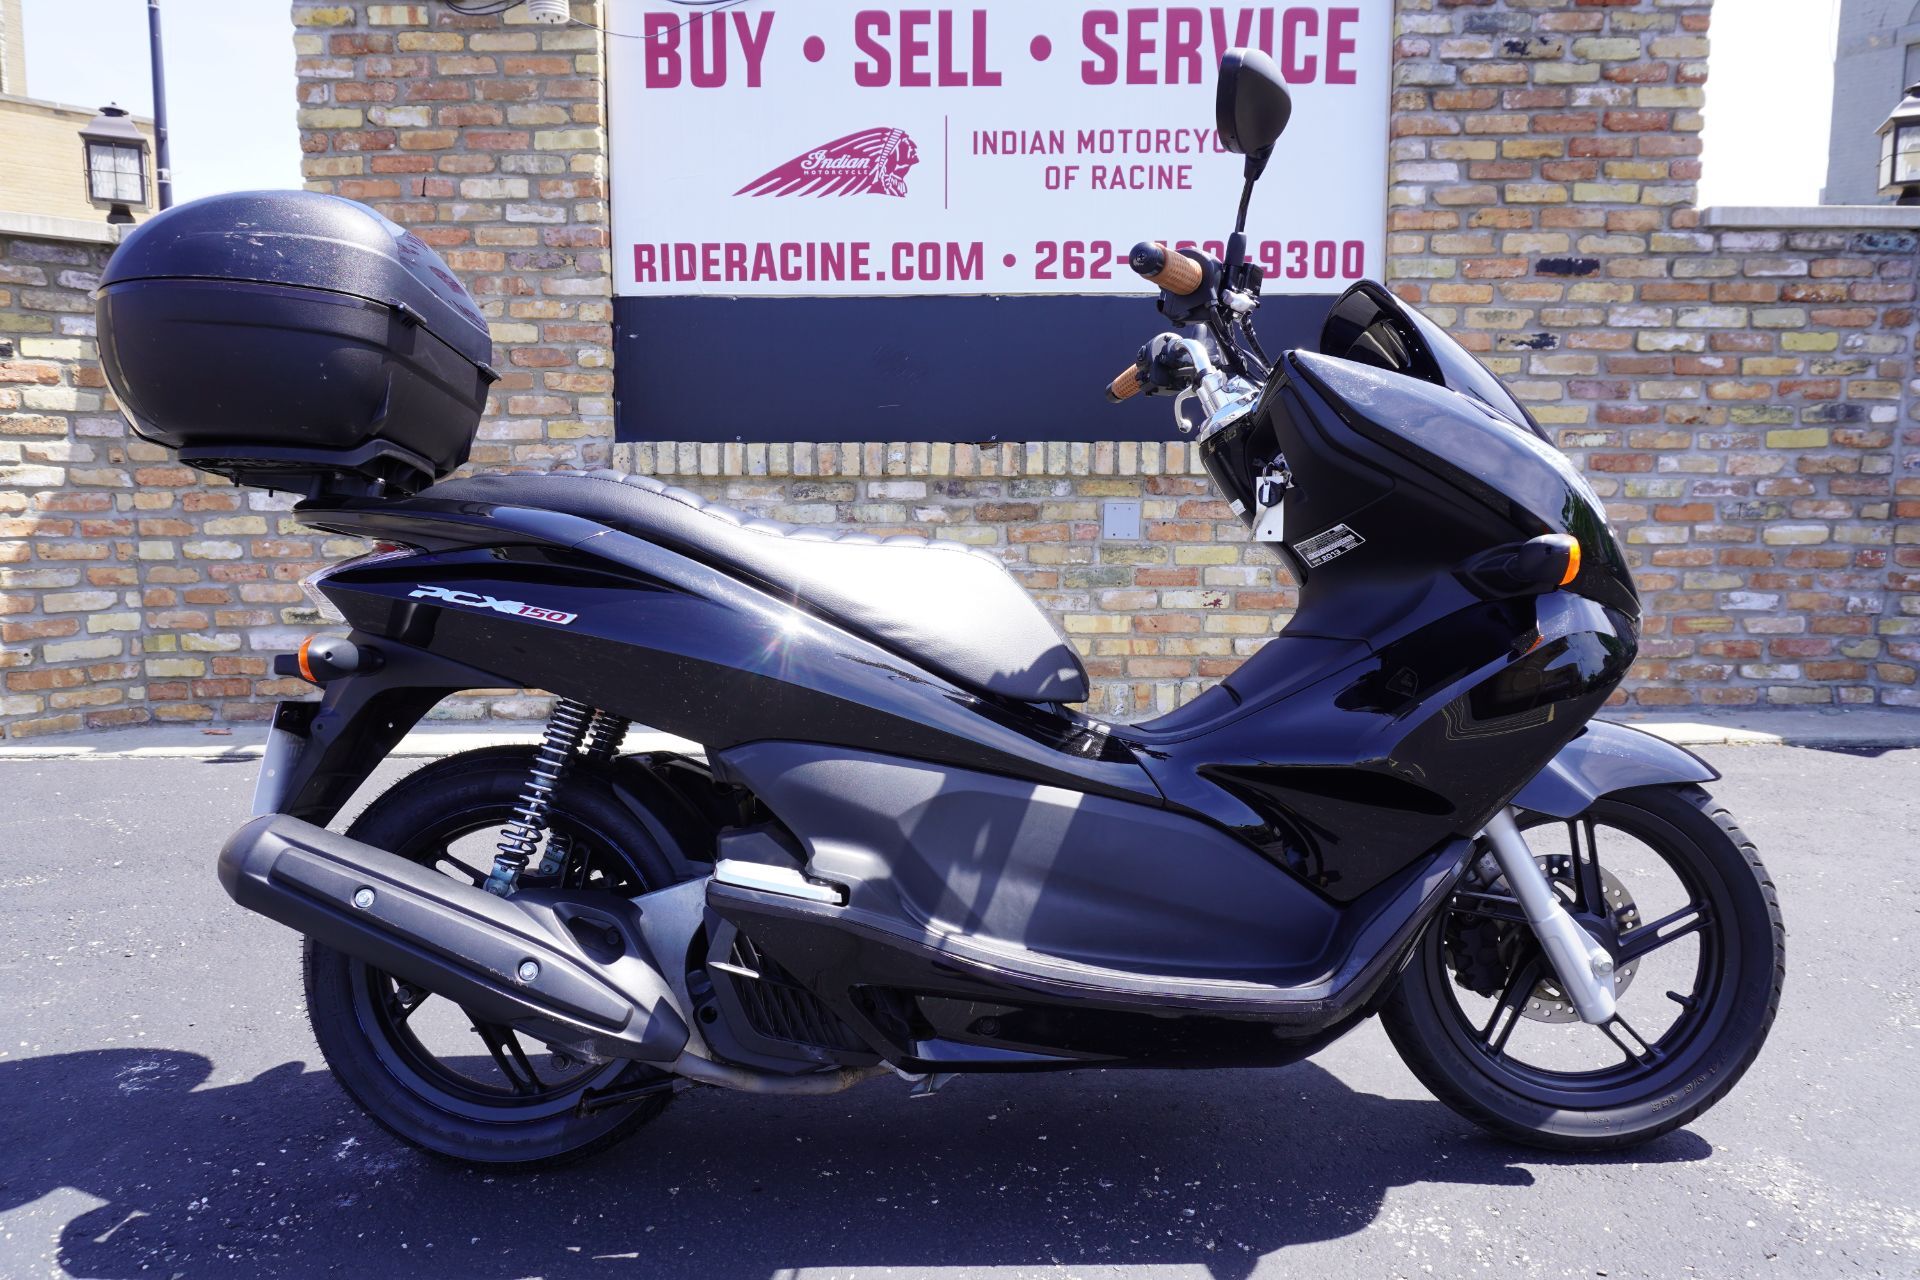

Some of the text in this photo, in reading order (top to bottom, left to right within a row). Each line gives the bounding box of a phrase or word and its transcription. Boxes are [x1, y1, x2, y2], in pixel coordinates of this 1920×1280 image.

[644, 7, 1360, 89] BUY SELL SERVICE
[972, 128, 1227, 155] INDIAN MOTORCYC
[800, 149, 871, 170] Indian
[1045, 165, 1193, 191] OF RACINE
[633, 240, 1365, 283] RIDERACINE.COM 262--9300
[1321, 548, 1341, 562] 2013
[408, 584, 568, 622] PCX 150
